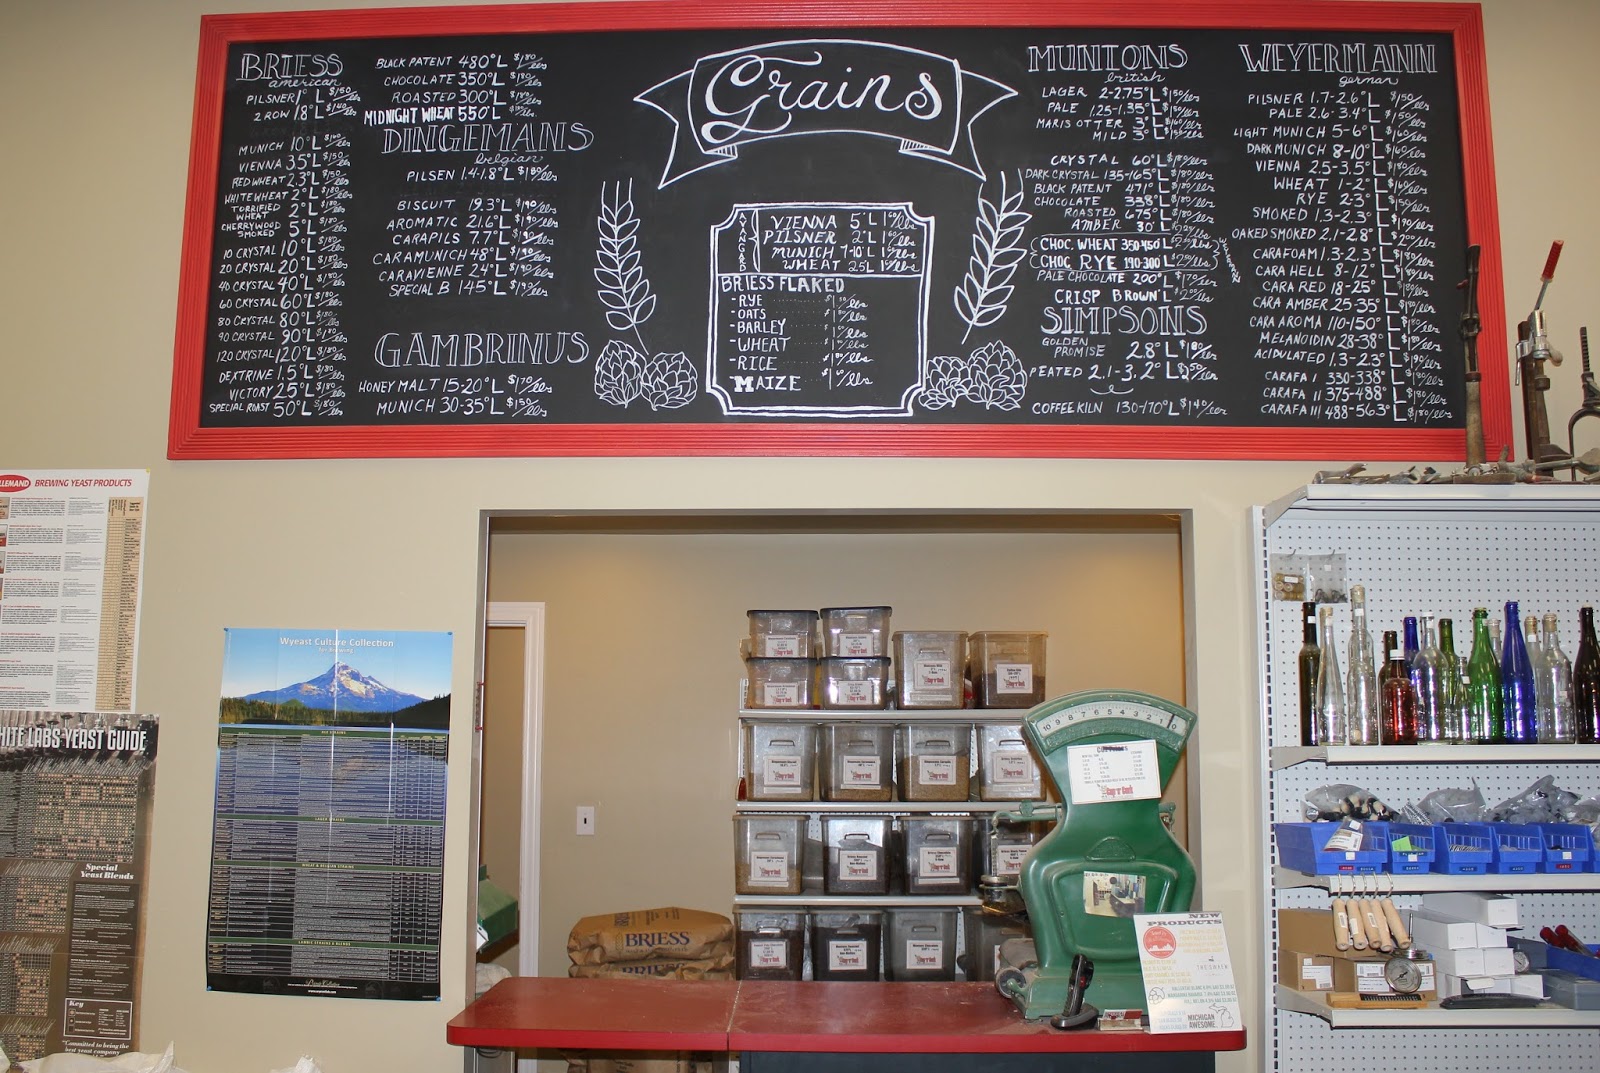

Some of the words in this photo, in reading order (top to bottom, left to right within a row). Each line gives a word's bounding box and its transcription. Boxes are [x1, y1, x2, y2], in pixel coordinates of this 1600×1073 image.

[376, 58, 406, 69] BLACK
[409, 56, 452, 67] PATENT
[1028, 44, 1188, 72] MUNTONS
[1238, 43, 1438, 74] WEYERMANN
[236, 53, 343, 81] BRIESS
[269, 78, 341, 88] american
[384, 73, 456, 86] CHOCOLATE
[1104, 71, 1166, 83] british
[1339, 75, 1398, 87] german
[392, 92, 456, 103] ROASTED
[700, 50, 943, 143] Grains
[1042, 87, 1088, 97] LAGER
[246, 93, 295, 105] PILSNER
[1248, 93, 1304, 105] PILSNER
[1047, 103, 1079, 113] PALE
[1269, 109, 1303, 119] PALE
[264, 110, 290, 120] ROW
[364, 107, 418, 126] MIDNIGHT
[422, 107, 453, 122] WHEAT
[1036, 119, 1071, 128] MARIS
[1076, 119, 1123, 128] OTTER
[381, 122, 594, 154] DINGEMANS
[1093, 131, 1127, 141] MILD
[1233, 126, 1267, 137] LIGHT
[1273, 126, 1326, 138] MUNICH
[238, 141, 284, 156] MUNICH
[474, 153, 543, 165] belgian
[1051, 154, 1119, 166] CRYSTAL
[239, 159, 282, 172] VIENNA
[1256, 159, 1300, 172] VIENNA
[406, 170, 455, 182] PILSEN
[1025, 169, 1050, 179] DARK
[1052, 169, 1100, 180] CRYSTAL
[1034, 184, 1066, 194] BLACK
[1071, 184, 1112, 193] PATENT
[1274, 177, 1329, 191] WHEAT
[1034, 197, 1101, 206] CHOCOLATE
[1296, 191, 1328, 205] RYE
[231, 203, 281, 213] TORRIFIED
[397, 200, 455, 211] BISCUIT
[236, 211, 269, 221] WHEAT
[1064, 208, 1116, 217] ROASTED
[1252, 207, 1308, 221] SMOKED
[221, 221, 281, 231] CHERRYWOOD
[387, 216, 458, 230] AROMATIC
[770, 215, 837, 230] VIENNA
[1071, 219, 1121, 230] AMBER
[238, 230, 275, 238] SMOKED
[392, 231, 460, 245] CARAPILS
[763, 230, 837, 245] PILSNER
[1077, 238, 1118, 251] WHEAT
[223, 250, 233, 260] 10
[236, 245, 276, 259] CRYSTAL
[372, 249, 467, 265] CARAMUNICH
[772, 247, 834, 258] MUNICH
[1253, 248, 1318, 260] CARAFOAM
[220, 264, 232, 274] 20
[235, 262, 276, 273] CRYSTAL
[783, 260, 840, 270] WHEAT
[1080, 255, 1117, 270] RYE
[379, 264, 464, 282] CARAVIENNE
[1037, 270, 1065, 281] PALE
[1068, 271, 1125, 283] CHOCOLATE
[1255, 266, 1285, 277] CARA
[1289, 265, 1324, 277] HELL
[218, 282, 230, 292] 40
[233, 281, 275, 292] CRYSTAL
[389, 283, 434, 297] SPECIAL
[437, 282, 450, 294] B
[721, 276, 774, 292] BRIESS
[780, 278, 845, 293] FLAKED
[1263, 281, 1294, 293] CARA
[1299, 282, 1326, 293] RED
[1055, 289, 1100, 304] CRISP
[1113, 289, 1157, 301] BROWN
[219, 298, 232, 309] 60
[236, 298, 278, 308] CRYSTAL
[1253, 296, 1281, 309] CARA
[1286, 297, 1329, 310] AMBER
[218, 317, 230, 327] 80
[234, 314, 275, 327] CRYSTAL
[1040, 306, 1207, 336] SIMPSONS
[1250, 316, 1275, 328] CARA
[1278, 316, 1322, 329] AROMA
[218, 332, 230, 341] 90
[232, 331, 275, 341] CRYSTAL
[1042, 337, 1089, 346] GOLDEN
[1260, 332, 1336, 346] MELANOIDIN
[374, 331, 589, 368] GAMBRINUS
[1054, 344, 1105, 358] PROMISE
[216, 352, 233, 363] 120
[235, 349, 274, 362] CRYSTAL
[1254, 348, 1326, 364] ACIDULATED
[219, 369, 274, 383] DEXTRINE
[1029, 366, 1082, 377] PEATED
[1265, 371, 1308, 382] CARAFA
[358, 380, 395, 393] HONEY
[398, 378, 440, 392] MALT
[229, 385, 274, 401] VICTORY
[1263, 387, 1306, 399] CARAFA
[209, 403, 244, 413] SPECIAL
[246, 402, 270, 413] ROAST
[376, 398, 436, 415] MUNICH
[1261, 403, 1307, 415] CARAFA
[35, 479, 69, 487] BREWING
[71, 479, 92, 487] YEAST
[93, 479, 132, 487] PRODUCTS
[280, 637, 312, 646] Wyeast
[349, 639, 394, 647] Collection
[1043, 724, 1051, 732] 10
[28, 728, 61, 748] LABS
[65, 729, 104, 749] YEAST
[108, 731, 147, 750] GUIDE
[104, 872, 134, 880] Blends
[625, 931, 690, 946] BRIESS
